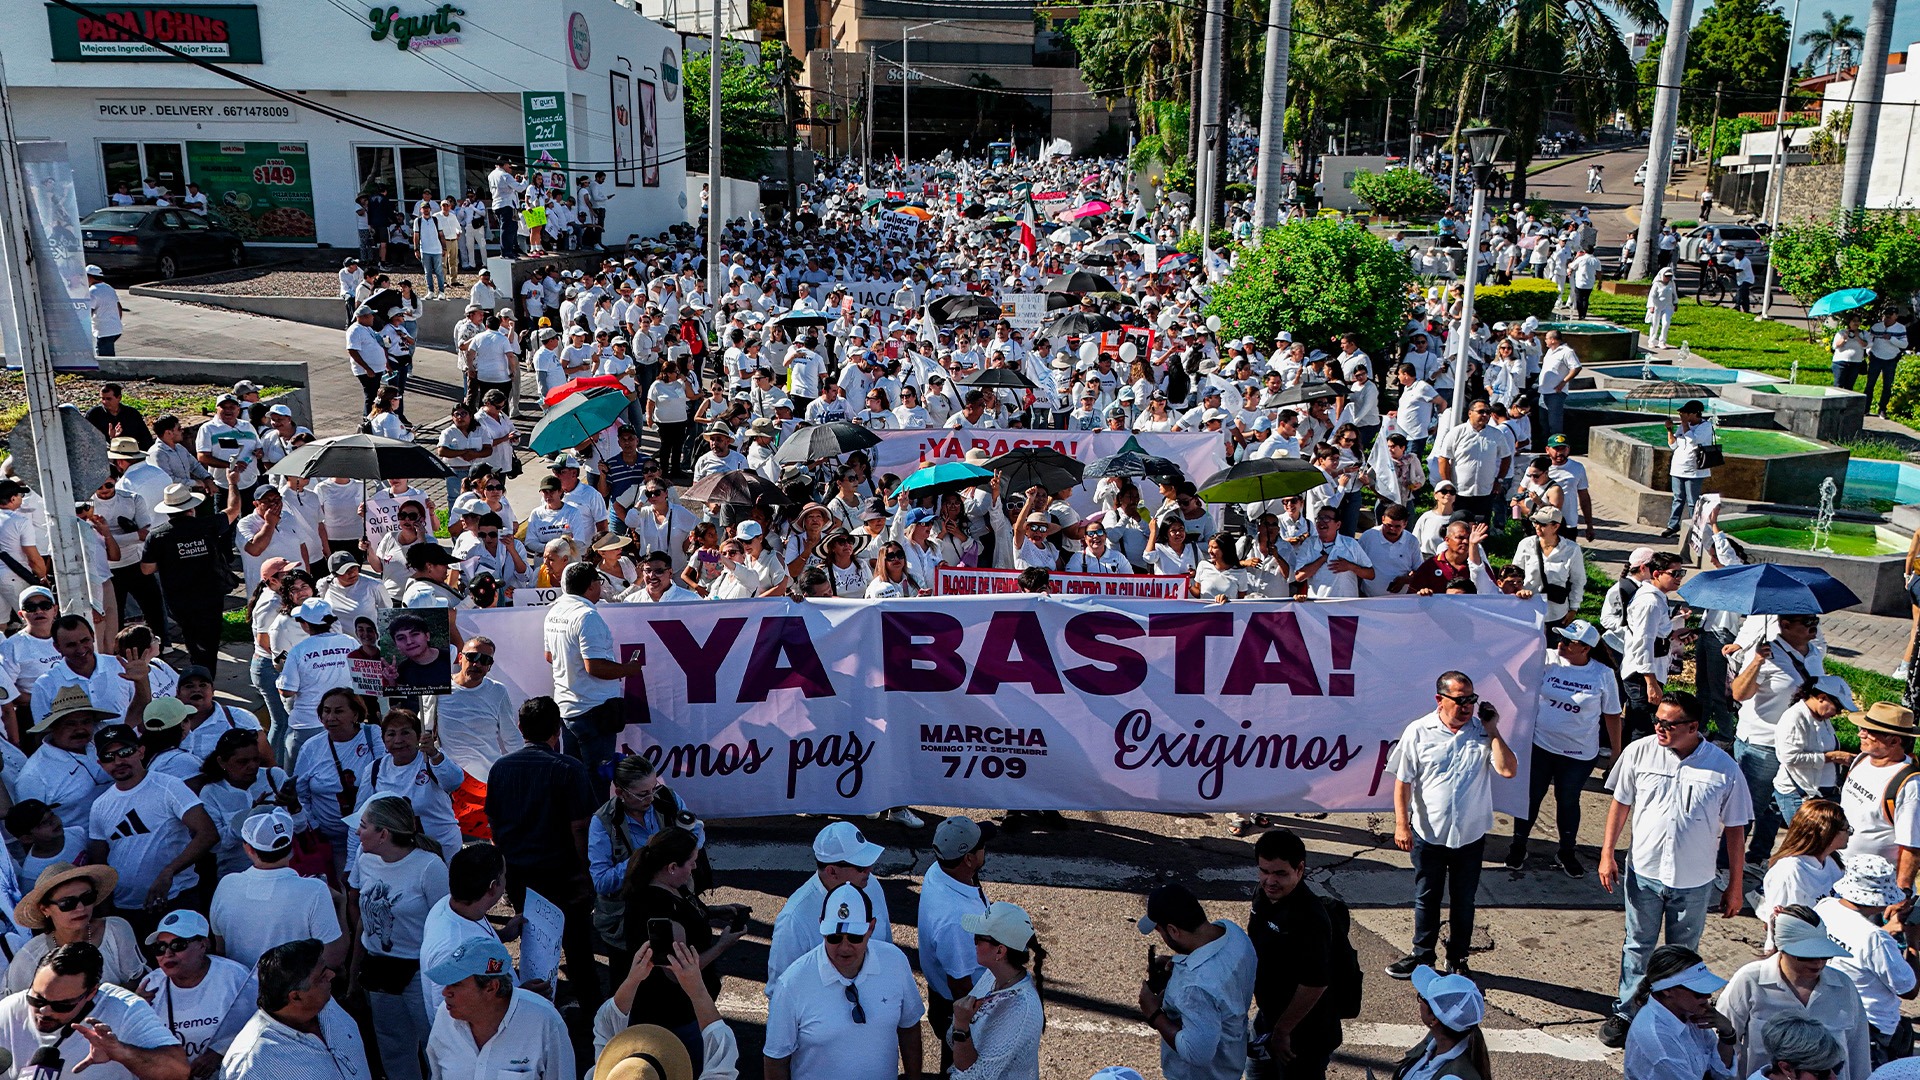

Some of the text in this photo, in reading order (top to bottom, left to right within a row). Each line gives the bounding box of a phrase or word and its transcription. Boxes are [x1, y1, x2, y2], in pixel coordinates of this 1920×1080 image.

[77, 10, 229, 42] PAPA JOHNS
[81, 44, 116, 53] Mejores
[201, 45, 226, 54] Pizza.
[100, 105, 127, 115] PICK
[130, 105, 147, 115] UP
[156, 105, 214, 116] DELIVERY
[223, 106, 289, 117] 6671478009
[253, 166, 295, 185] $149
[881, 210, 918, 227] Culiacán
[919, 437, 965, 463] ¡YA
[376, 506, 390, 515] YO
[369, 516, 389, 525] QUE
[371, 526, 383, 534] MI
[177, 539, 205, 549] Portal
[179, 545, 208, 555] Capital
[942, 574, 977, 595] BLOQUE
[979, 576, 990, 595] DE
[1066, 580, 1100, 595] CENTRO
[1118, 578, 1163, 599] CULIACÁN
[536, 590, 557, 602] YO
[322, 648, 350, 656] BASTA
[620, 610, 1359, 725] ¡YA BASTA!
[1562, 679, 1592, 690] BASTA!
[1549, 699, 1581, 714] 7/09
[920, 724, 1047, 747] MARCHA
[991, 746, 1048, 756] SEPTIEMBRE
[1114, 708, 1363, 801] Exigimos
[788, 729, 876, 800] paz
[941, 755, 1027, 779] 7/09
[1852, 782, 1877, 802] BASTA!
